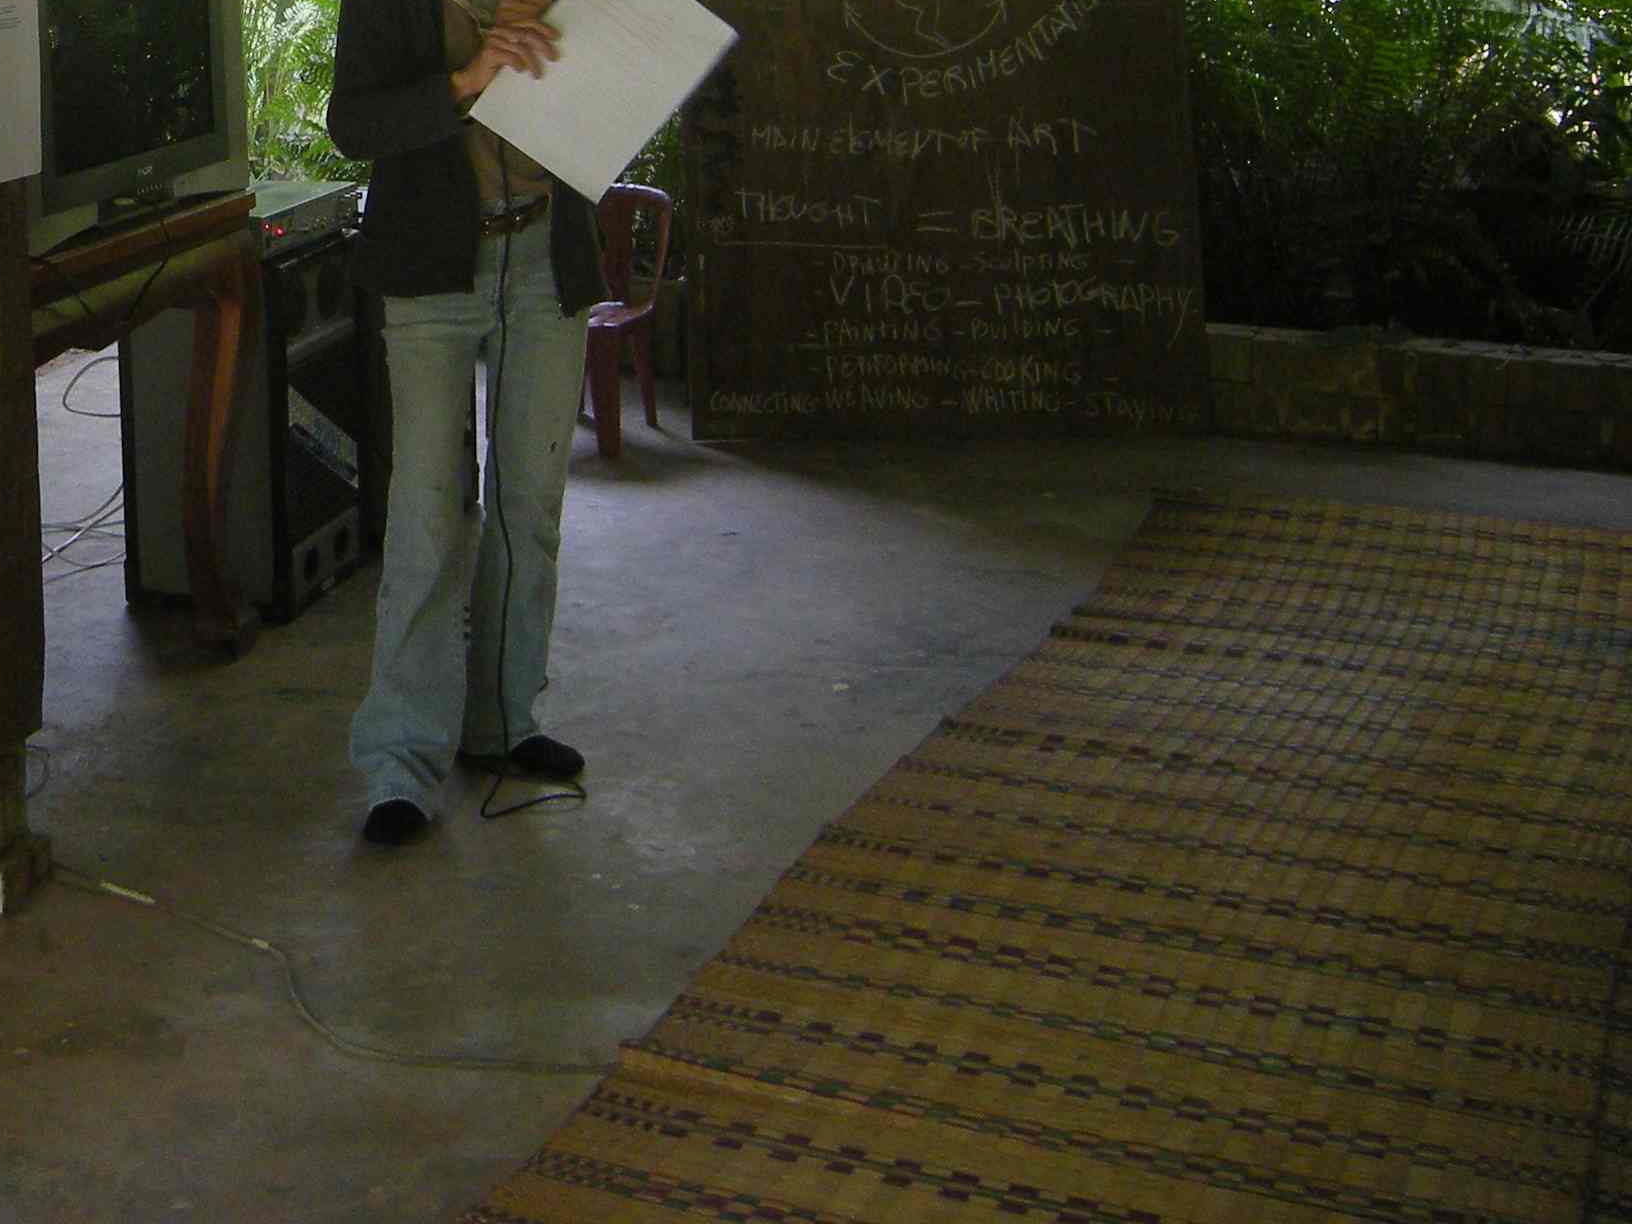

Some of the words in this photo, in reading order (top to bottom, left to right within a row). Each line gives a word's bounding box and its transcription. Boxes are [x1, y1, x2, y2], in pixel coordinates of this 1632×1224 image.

[1007, 116, 1100, 156] ART
[734, 186, 882, 232] THOUGHT
[970, 203, 1182, 249] BREATHING
[828, 273, 953, 316] VIDEO
[822, 315, 945, 347] PAINTING
